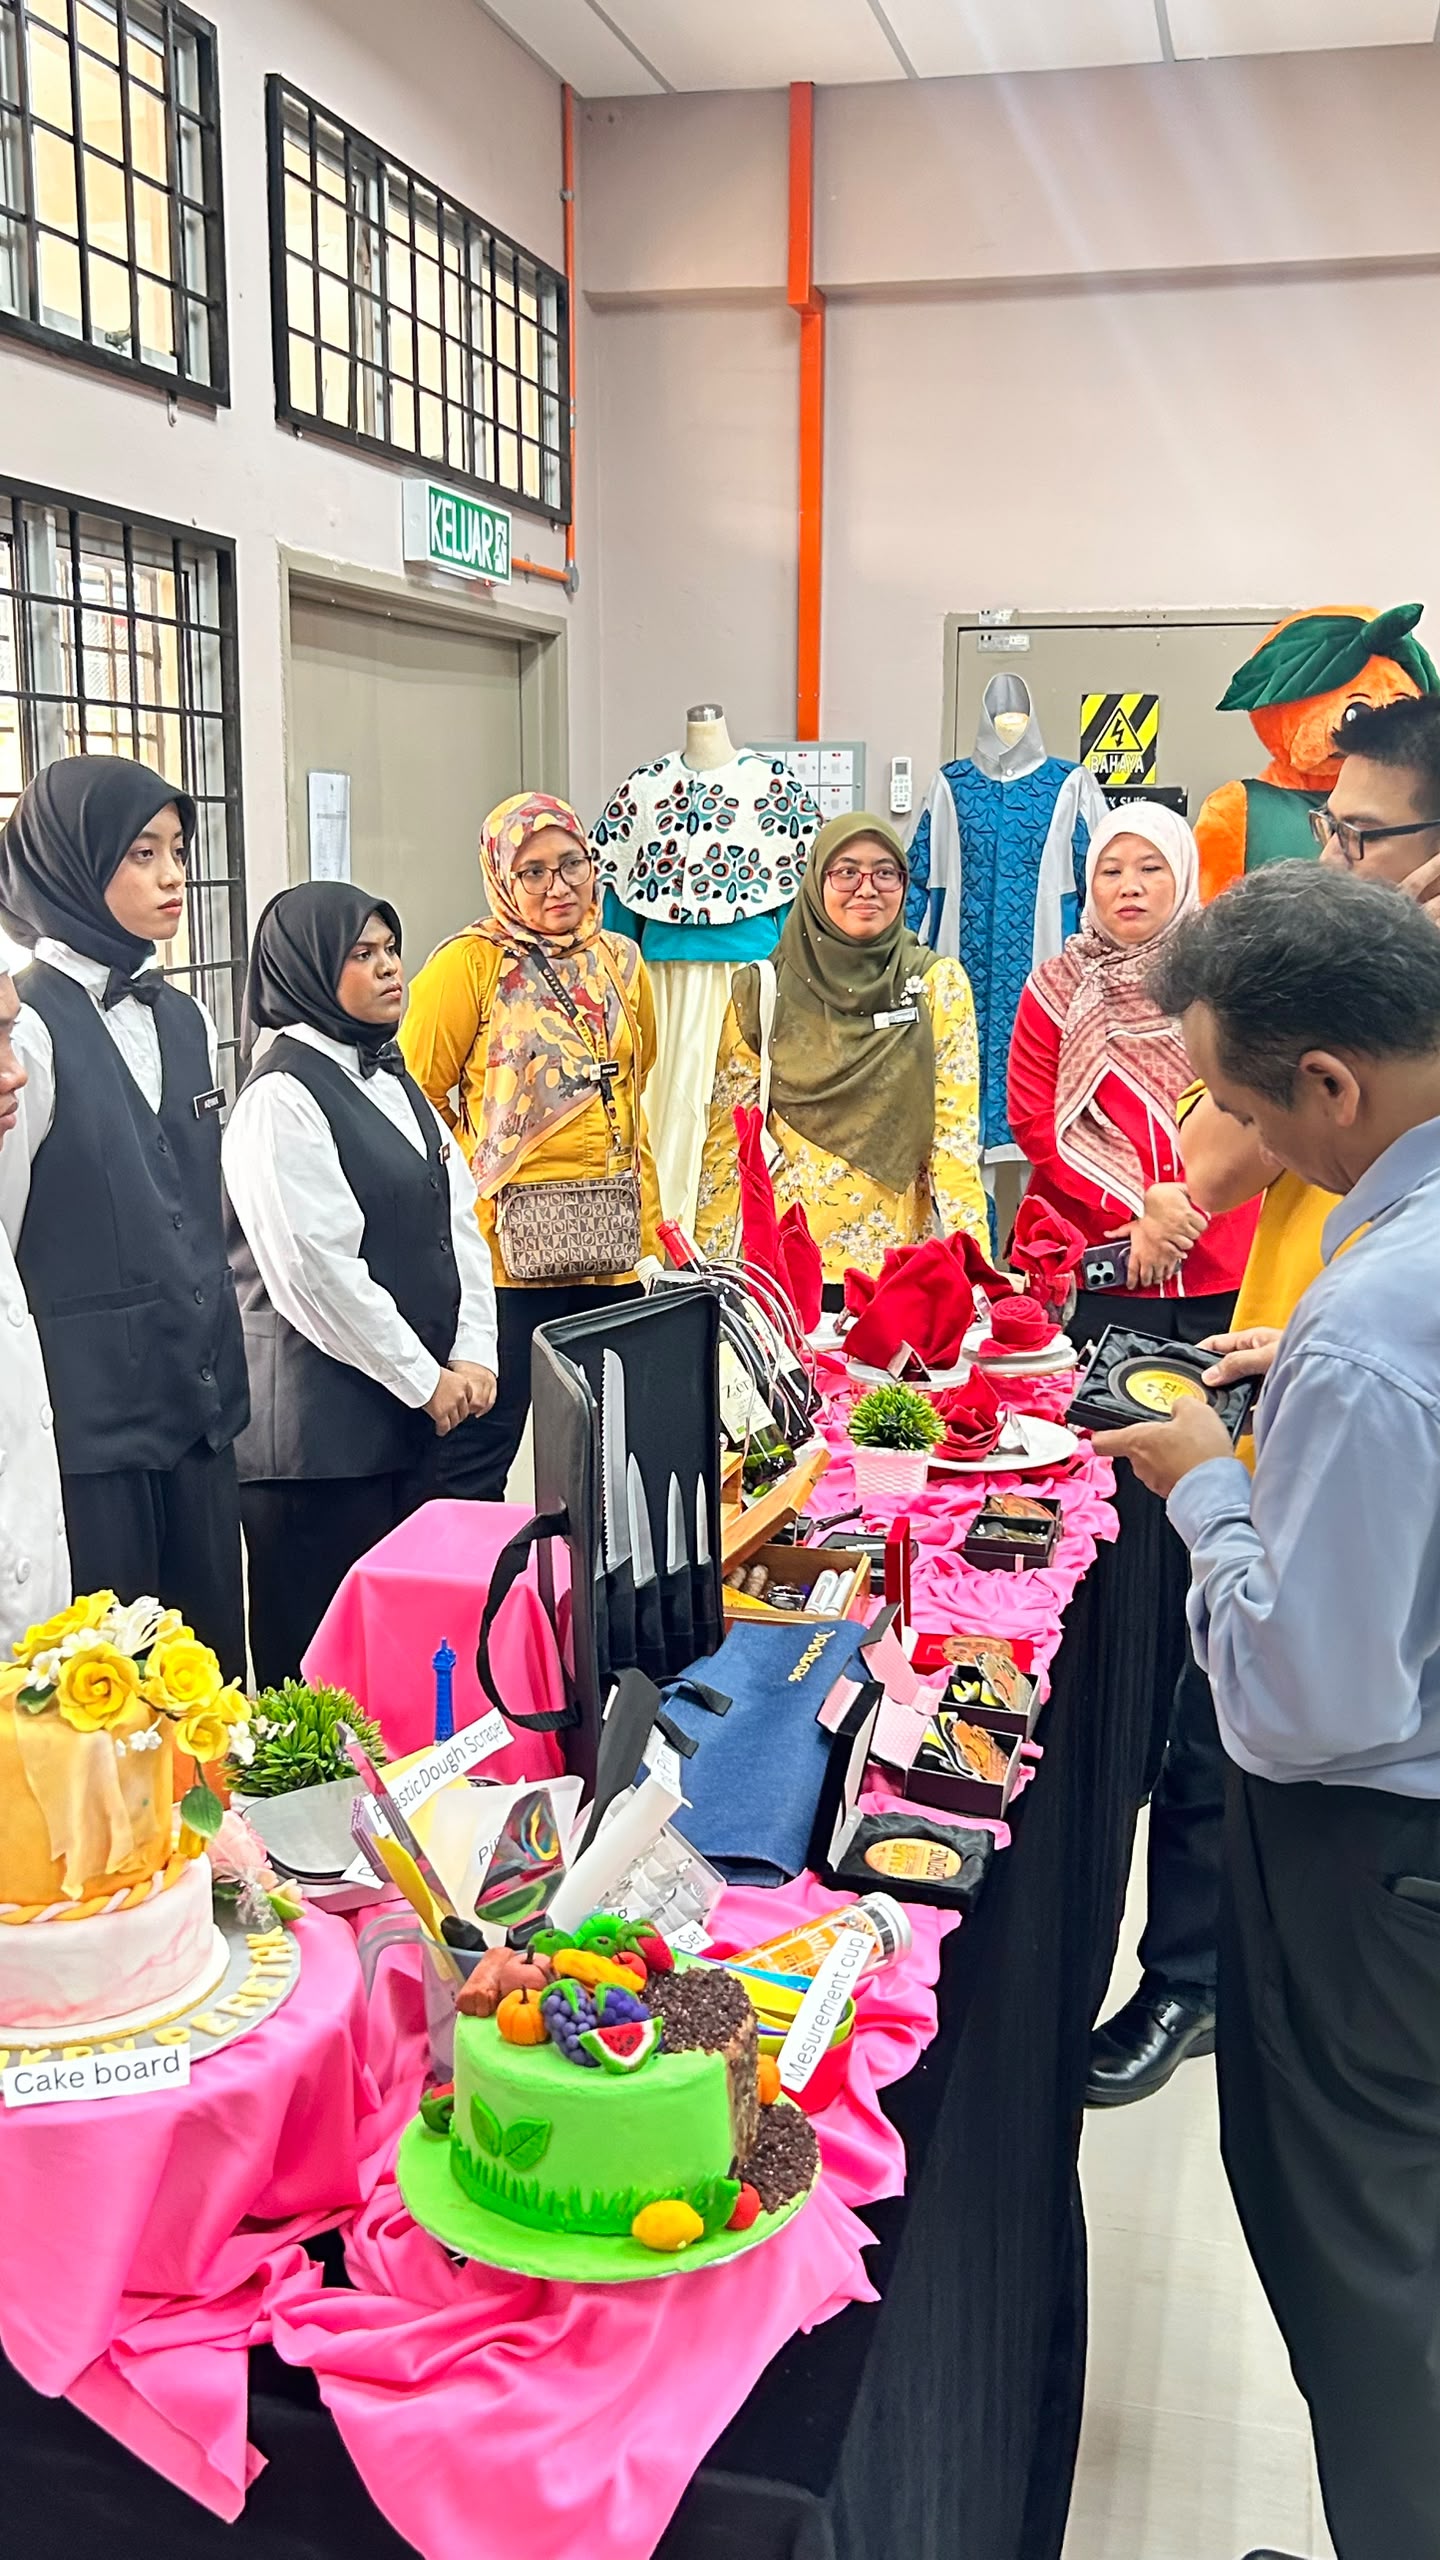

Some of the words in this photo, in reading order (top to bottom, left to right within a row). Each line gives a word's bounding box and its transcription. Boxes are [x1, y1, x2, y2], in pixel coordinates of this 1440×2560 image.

[430, 493, 493, 570] KELUAR
[1090, 755, 1144, 774] BAHAYA
[373, 1780, 422, 1824] Pastic
[419, 1746, 467, 1788] Dough
[464, 1719, 505, 1753] Scraper
[926, 1848, 949, 1878] BRONZE
[678, 1930, 706, 1950] Set
[784, 1971, 850, 2082] Mesurement
[841, 1937, 867, 1969] cup
[14, 2067, 85, 2095] Cake
[94, 2049, 180, 2085] board
